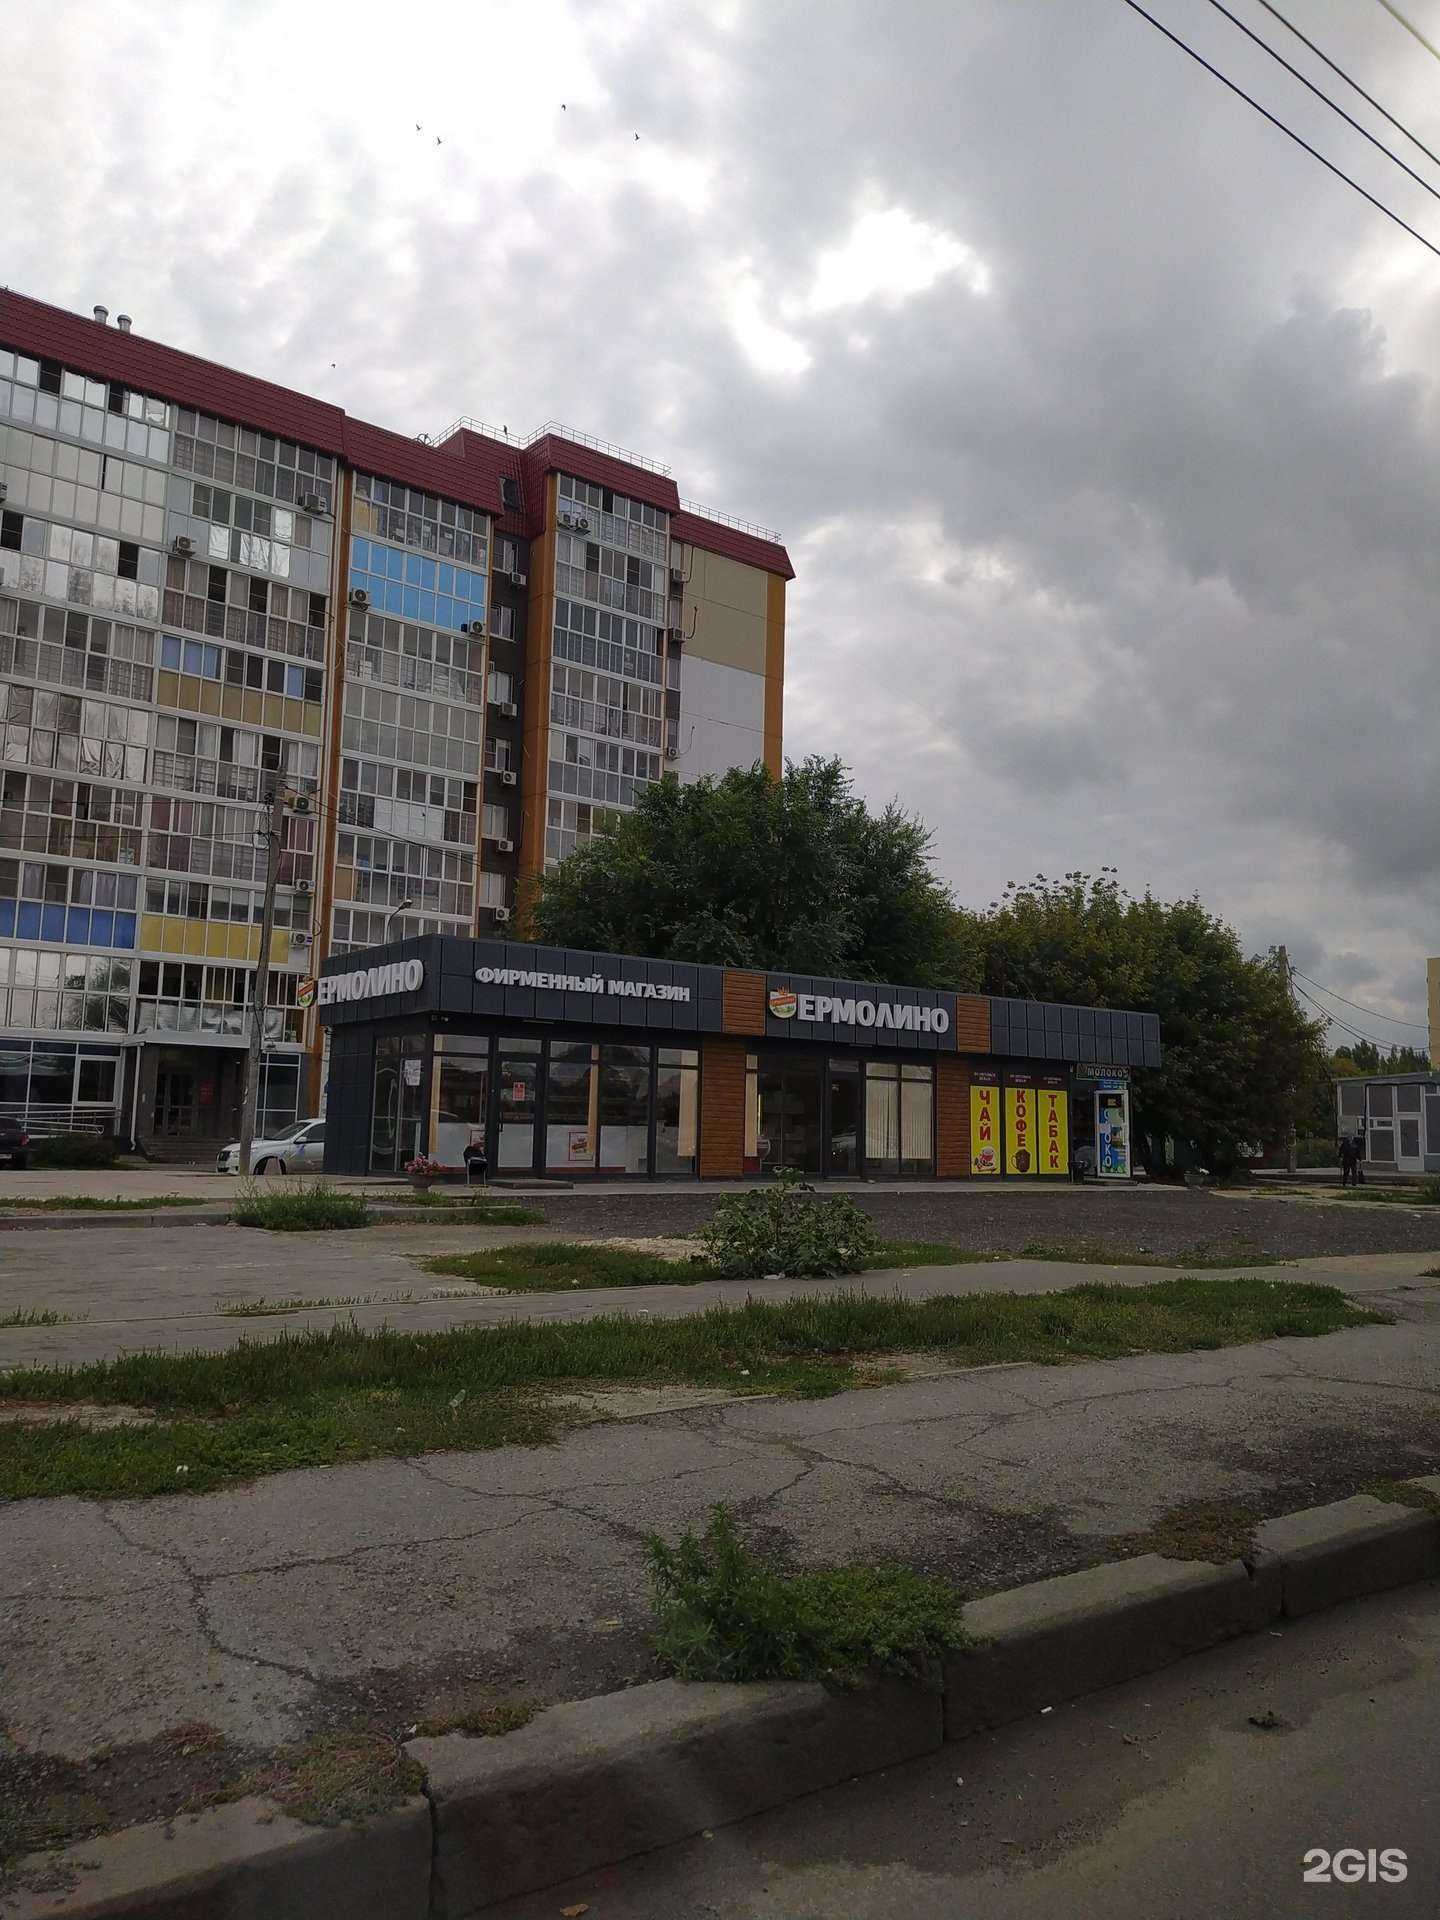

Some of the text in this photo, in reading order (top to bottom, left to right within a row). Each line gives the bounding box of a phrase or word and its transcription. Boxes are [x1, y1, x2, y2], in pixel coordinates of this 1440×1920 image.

[317, 958, 424, 1005] ЕРМОЛИНО
[474, 966, 691, 1002] ФИРМЕННЫЙ МАГАЗИН
[797, 993, 950, 1034] ЕРМОЛИНО
[979, 1089, 992, 1141] ЧАЙ
[1015, 1089, 1027, 1147] КОФЕ
[1048, 1094, 1060, 1169] ТАБАК
